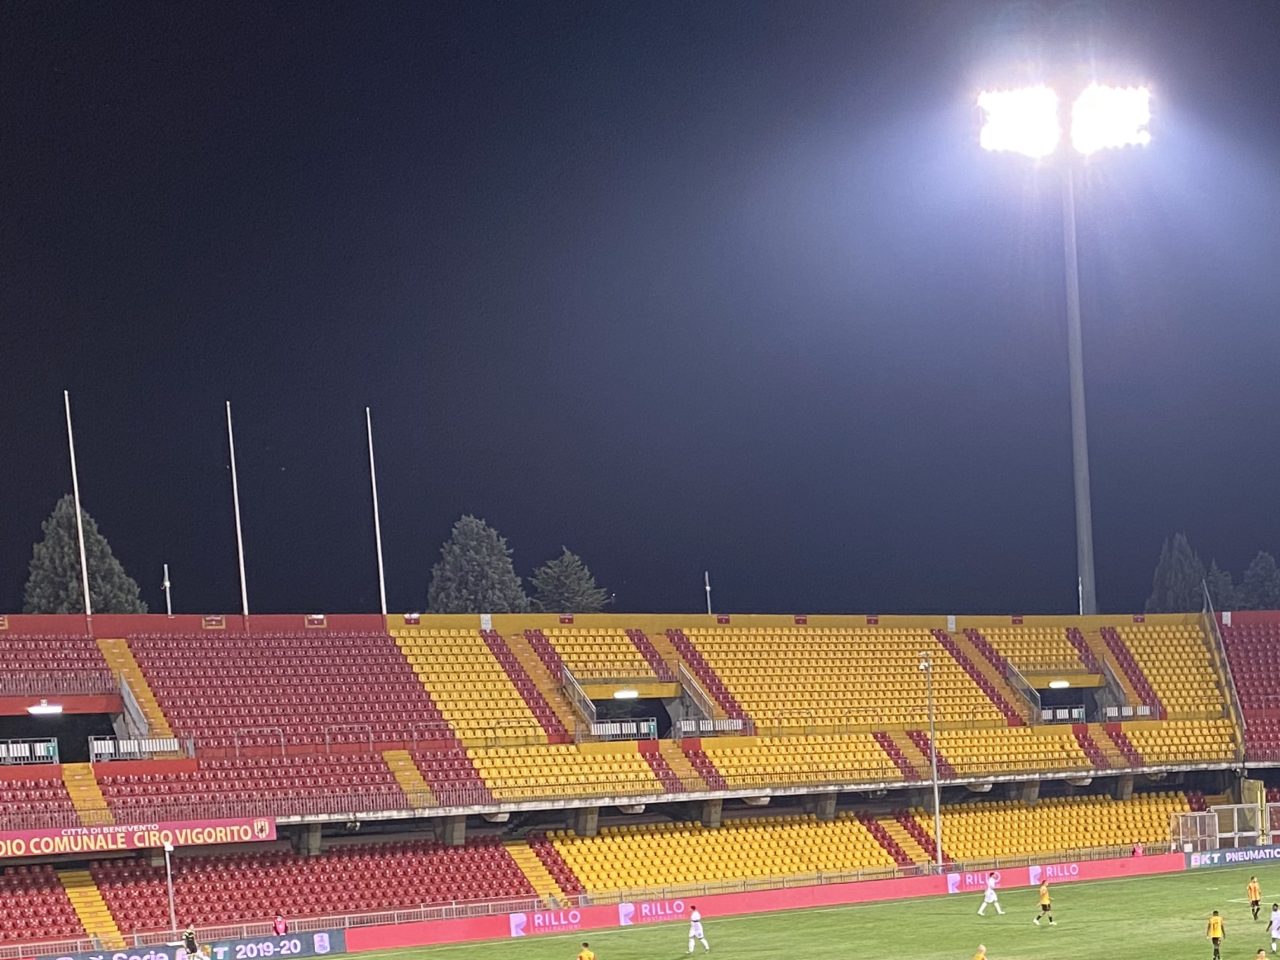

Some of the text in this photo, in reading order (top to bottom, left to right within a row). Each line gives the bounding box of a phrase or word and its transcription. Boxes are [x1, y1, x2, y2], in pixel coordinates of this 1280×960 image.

[61, 827, 89, 836] CITTÀ
[103, 823, 159, 834] BENEVENTO
[29, 833, 127, 854] COMUNALE
[133, 830, 172, 848] CIRO
[175, 825, 252, 845] VIGORITO
[1191, 852, 1221, 867] BKT
[1046, 864, 1079, 877] RILLO
[641, 900, 685, 917] RILLO
[534, 910, 581, 928] RILLO
[235, 939, 302, 960] 2019-20
